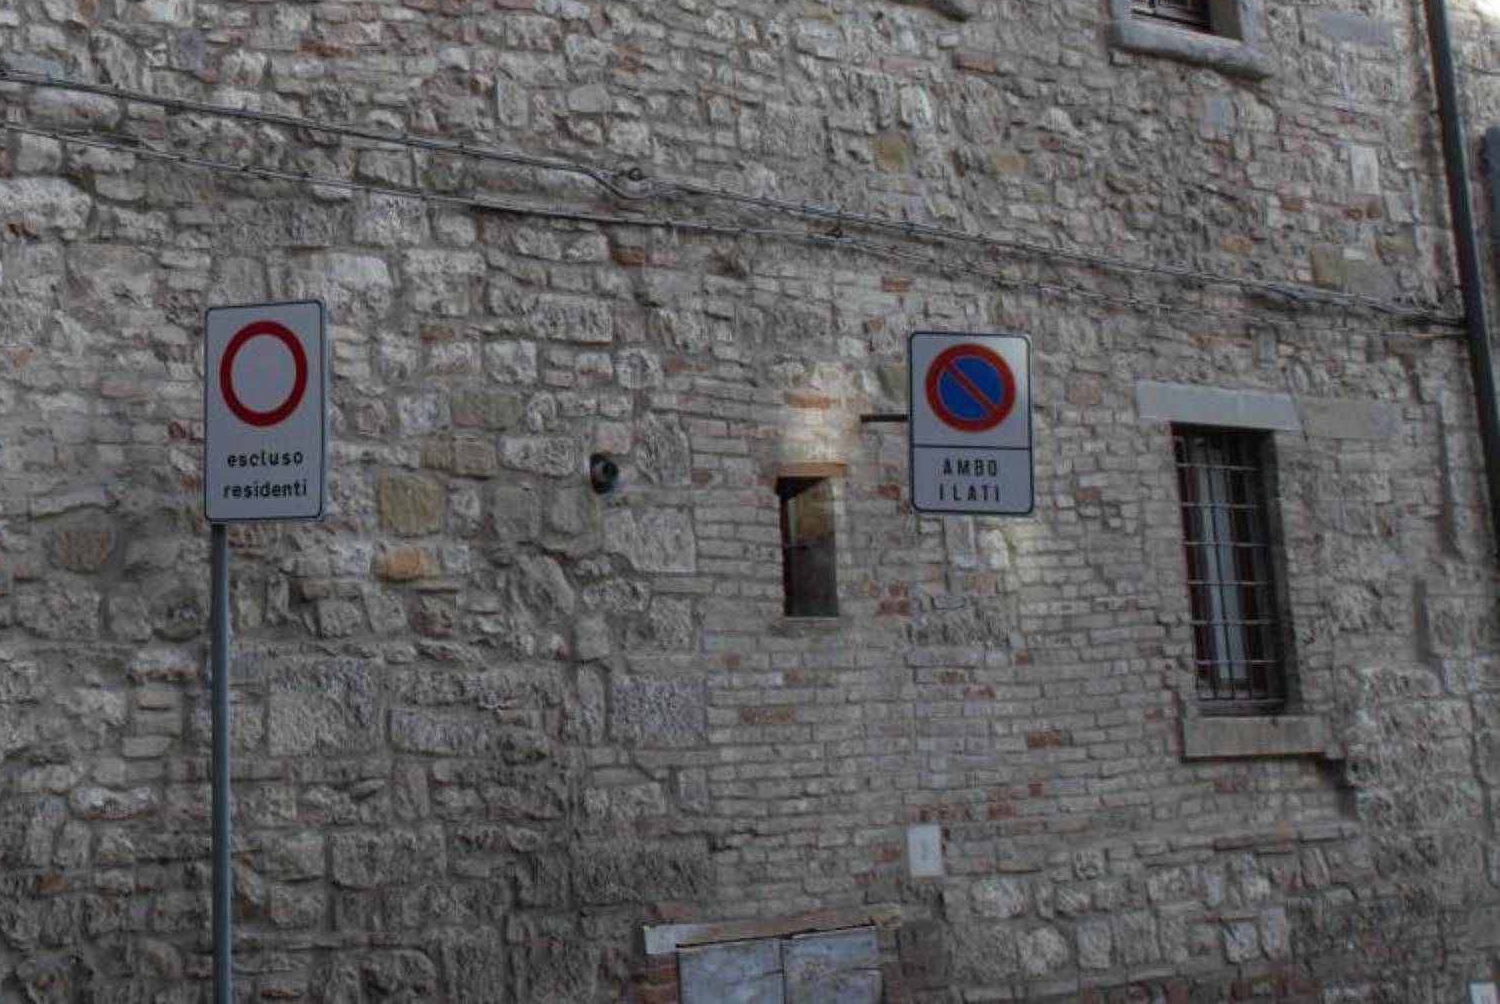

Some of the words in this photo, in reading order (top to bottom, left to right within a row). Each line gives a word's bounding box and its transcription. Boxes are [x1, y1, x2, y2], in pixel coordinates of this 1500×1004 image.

[226, 449, 305, 468] escluso
[942, 457, 998, 477] AMBO
[222, 479, 308, 499] residenti
